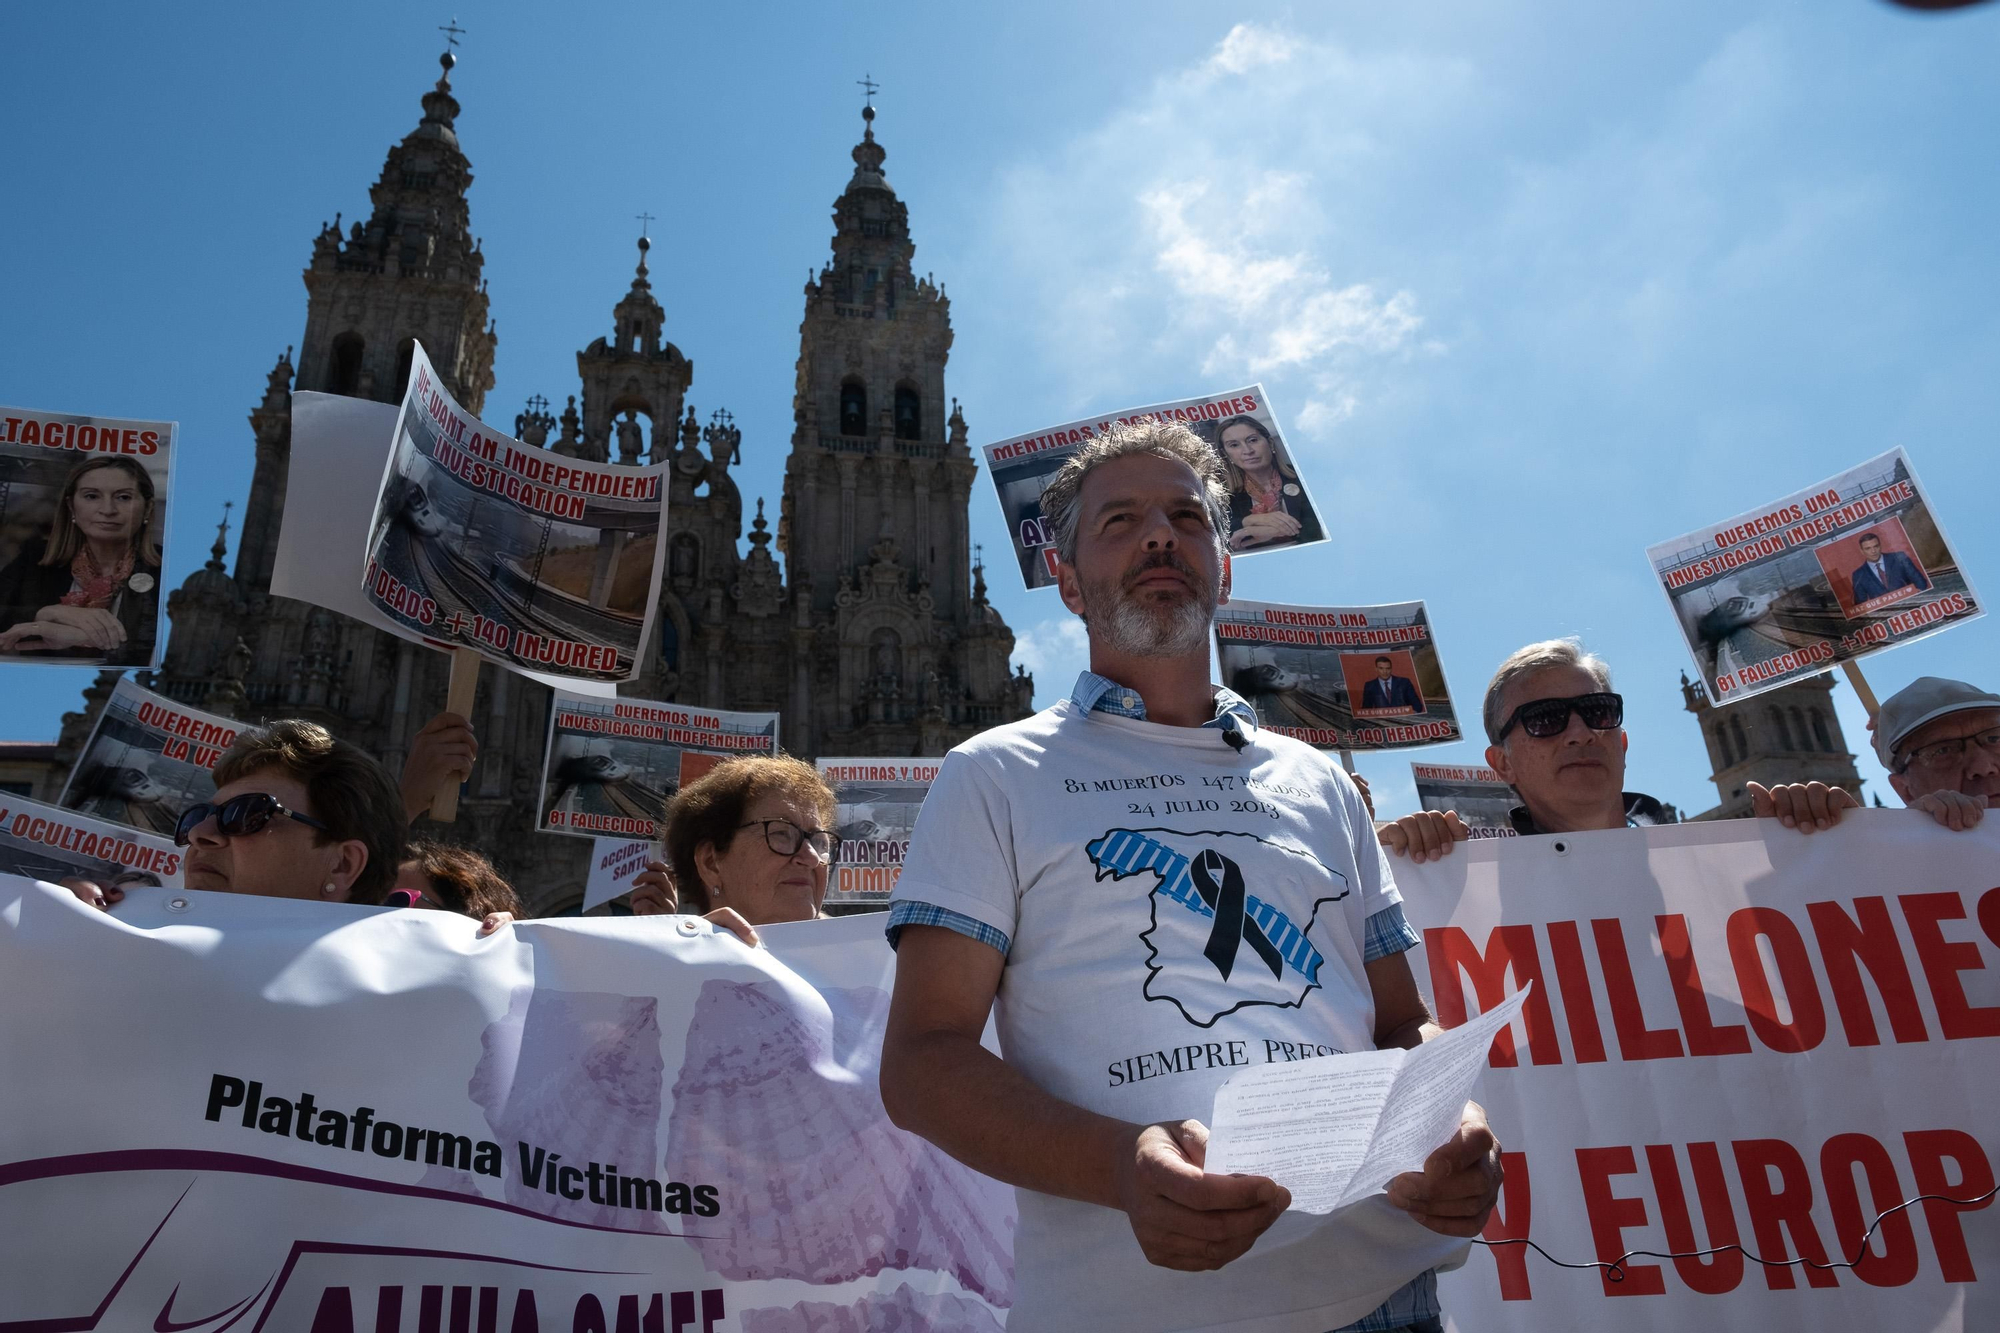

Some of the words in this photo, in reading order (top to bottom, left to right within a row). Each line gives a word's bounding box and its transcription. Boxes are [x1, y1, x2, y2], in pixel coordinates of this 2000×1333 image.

[0, 417, 158, 456] TACIONES
[417, 363, 431, 403] WE
[428, 389, 467, 444] WANT
[468, 432, 498, 463] AN
[503, 446, 658, 498] INDEPENDIENT
[992, 425, 1095, 461] MENTIRAS
[1117, 394, 1258, 428] CLTACIONES
[433, 434, 586, 520] INVESTIGATION
[1665, 536, 1786, 589] INVESTIGACIÓN
[1787, 480, 1914, 545] INDEPENDIENTE
[1713, 504, 1801, 550] QUEREMOS
[1804, 488, 1842, 512] UNA
[375, 568, 436, 626] DEADS
[513, 631, 618, 672] INJURED
[1218, 623, 1318, 645] INVESTIGACIÓN
[1320, 624, 1427, 646] INDEPENDIENTE
[1264, 609, 1336, 627] QUEREMOS
[1340, 612, 1368, 627] UNA
[1716, 672, 1734, 693] 81
[1737, 641, 1835, 686] FALLECIDOS
[1889, 592, 1967, 635] HERIDOS
[137, 701, 237, 749] QUEREMO
[558, 713, 664, 740] INVESTIGACIÓN
[668, 727, 771, 750] INDEPENDIENTE
[614, 703, 689, 726] QUEREMOS
[693, 715, 720, 730] UNA
[1258, 725, 1338, 744] ECIDOS
[1386, 720, 1451, 743] HERIDOS
[161, 737, 190, 762] LA
[826, 766, 896, 782] MENTIRAS
[900, 766, 909, 781] Y
[1064, 778, 1089, 794] 81
[1091, 774, 1186, 793] MUERTOS
[1199, 775, 1235, 791] 147
[1415, 766, 1466, 781] MENTIRAS
[1467, 769, 1474, 780] Y
[549, 810, 566, 826] 81
[570, 812, 654, 835] FALLECIDOS
[1127, 802, 1155, 818] 24
[1164, 799, 1220, 815] JULIO
[1231, 800, 1281, 820] 2013
[10, 813, 181, 876] OCULTACIONES
[840, 840, 869, 863] NA
[612, 854, 650, 881] SANTI
[1107, 1040, 1250, 1088] SIEMPRE
[1261, 1038, 1349, 1063] PRES
[204, 1073, 502, 1179] Plataforma
[517, 1140, 722, 1218] Víctimas
[1482, 1151, 1532, 1301] Y
[1575, 1128, 1996, 1299] EUROP
